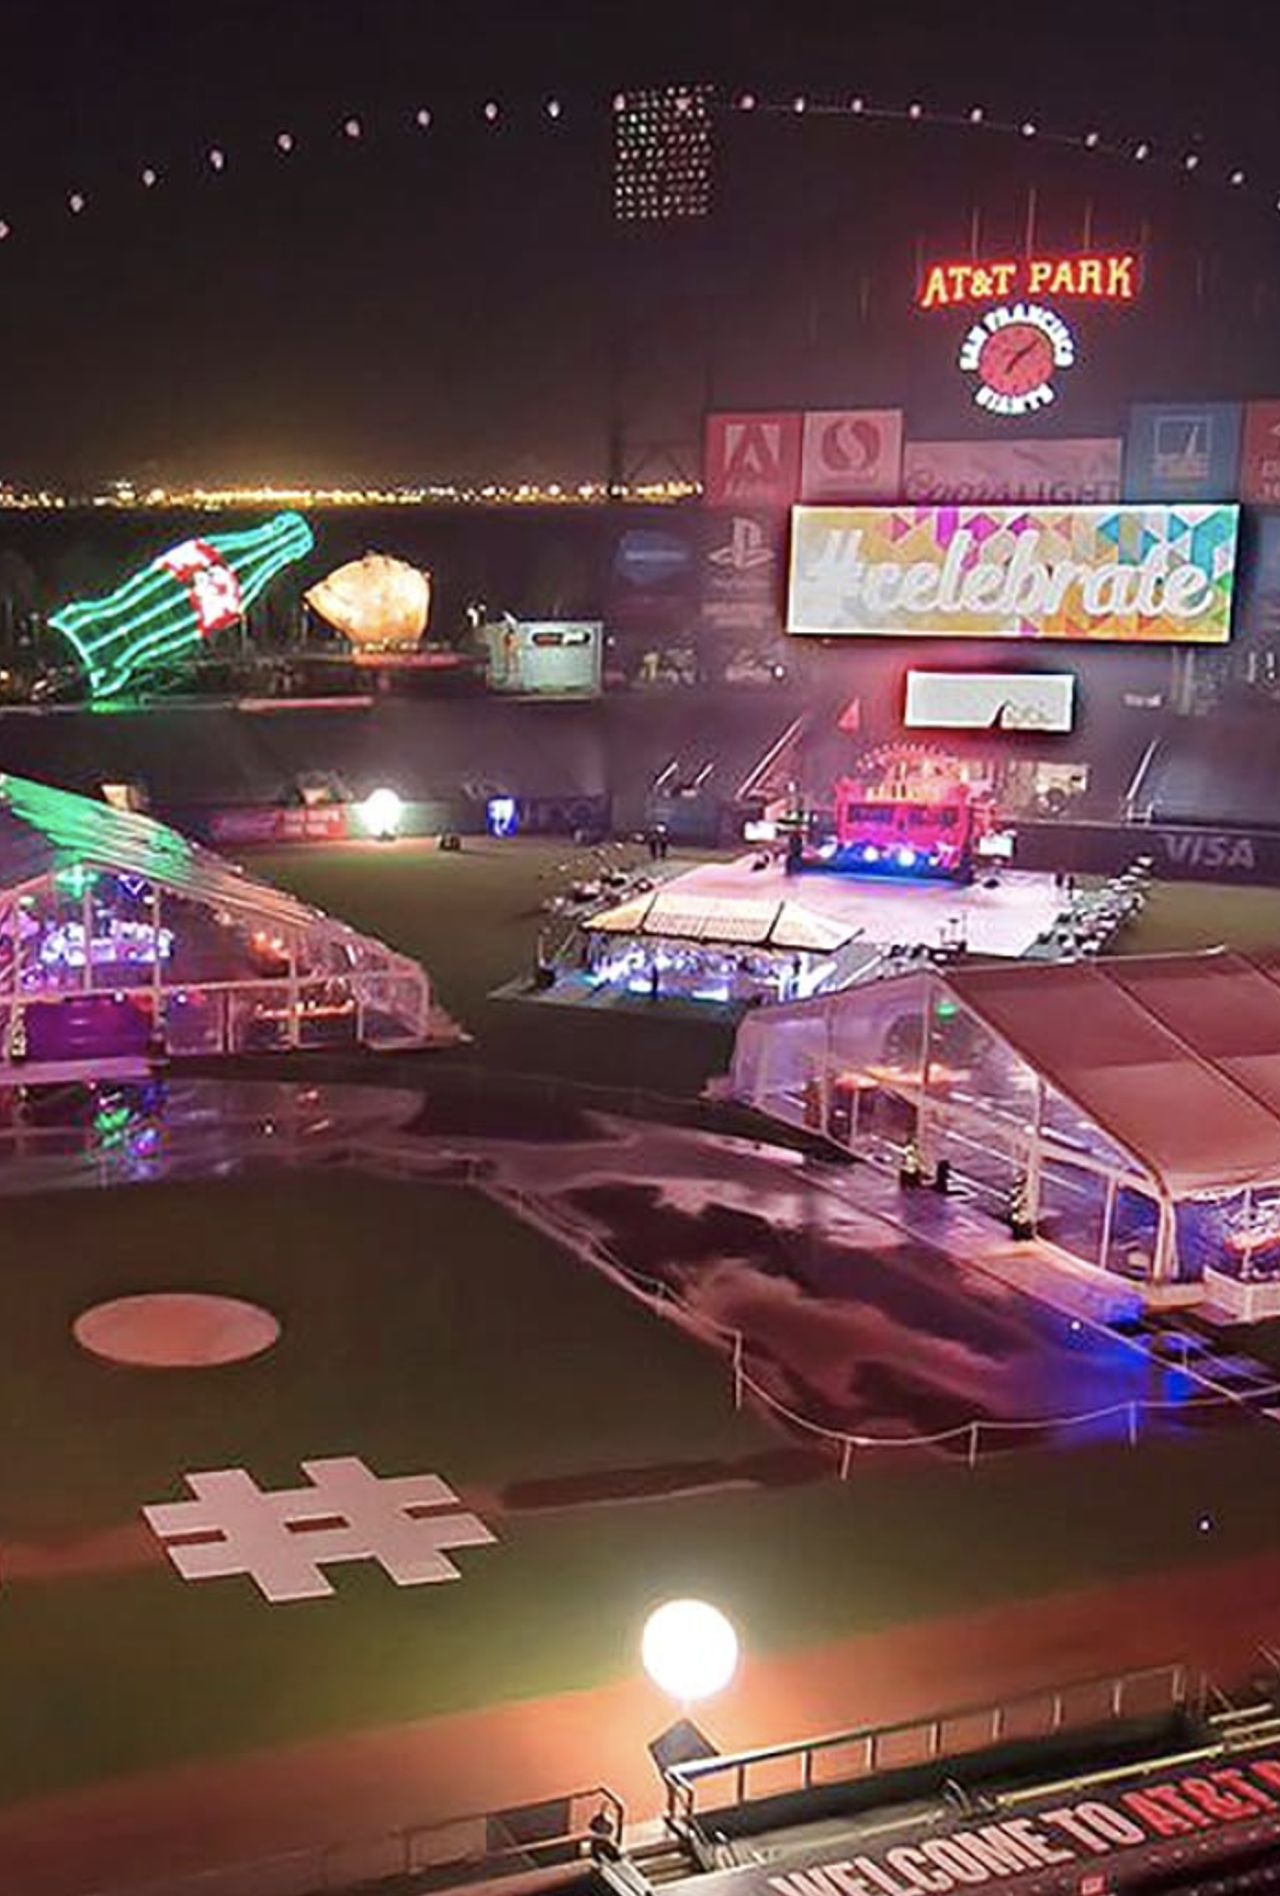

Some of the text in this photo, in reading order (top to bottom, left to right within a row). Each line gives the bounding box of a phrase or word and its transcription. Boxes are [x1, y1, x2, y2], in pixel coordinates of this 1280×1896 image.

[921, 256, 1133, 307] AT&T PARK
[959, 303, 1074, 371] SAN FRANCISCO
[974, 383, 1055, 415] GIANTS
[802, 528, 1217, 618] #celebrate
[1160, 833, 1256, 869] VISA
[1040, 1801, 1144, 1851] TO
[1121, 1769, 1278, 1836] AT&T
